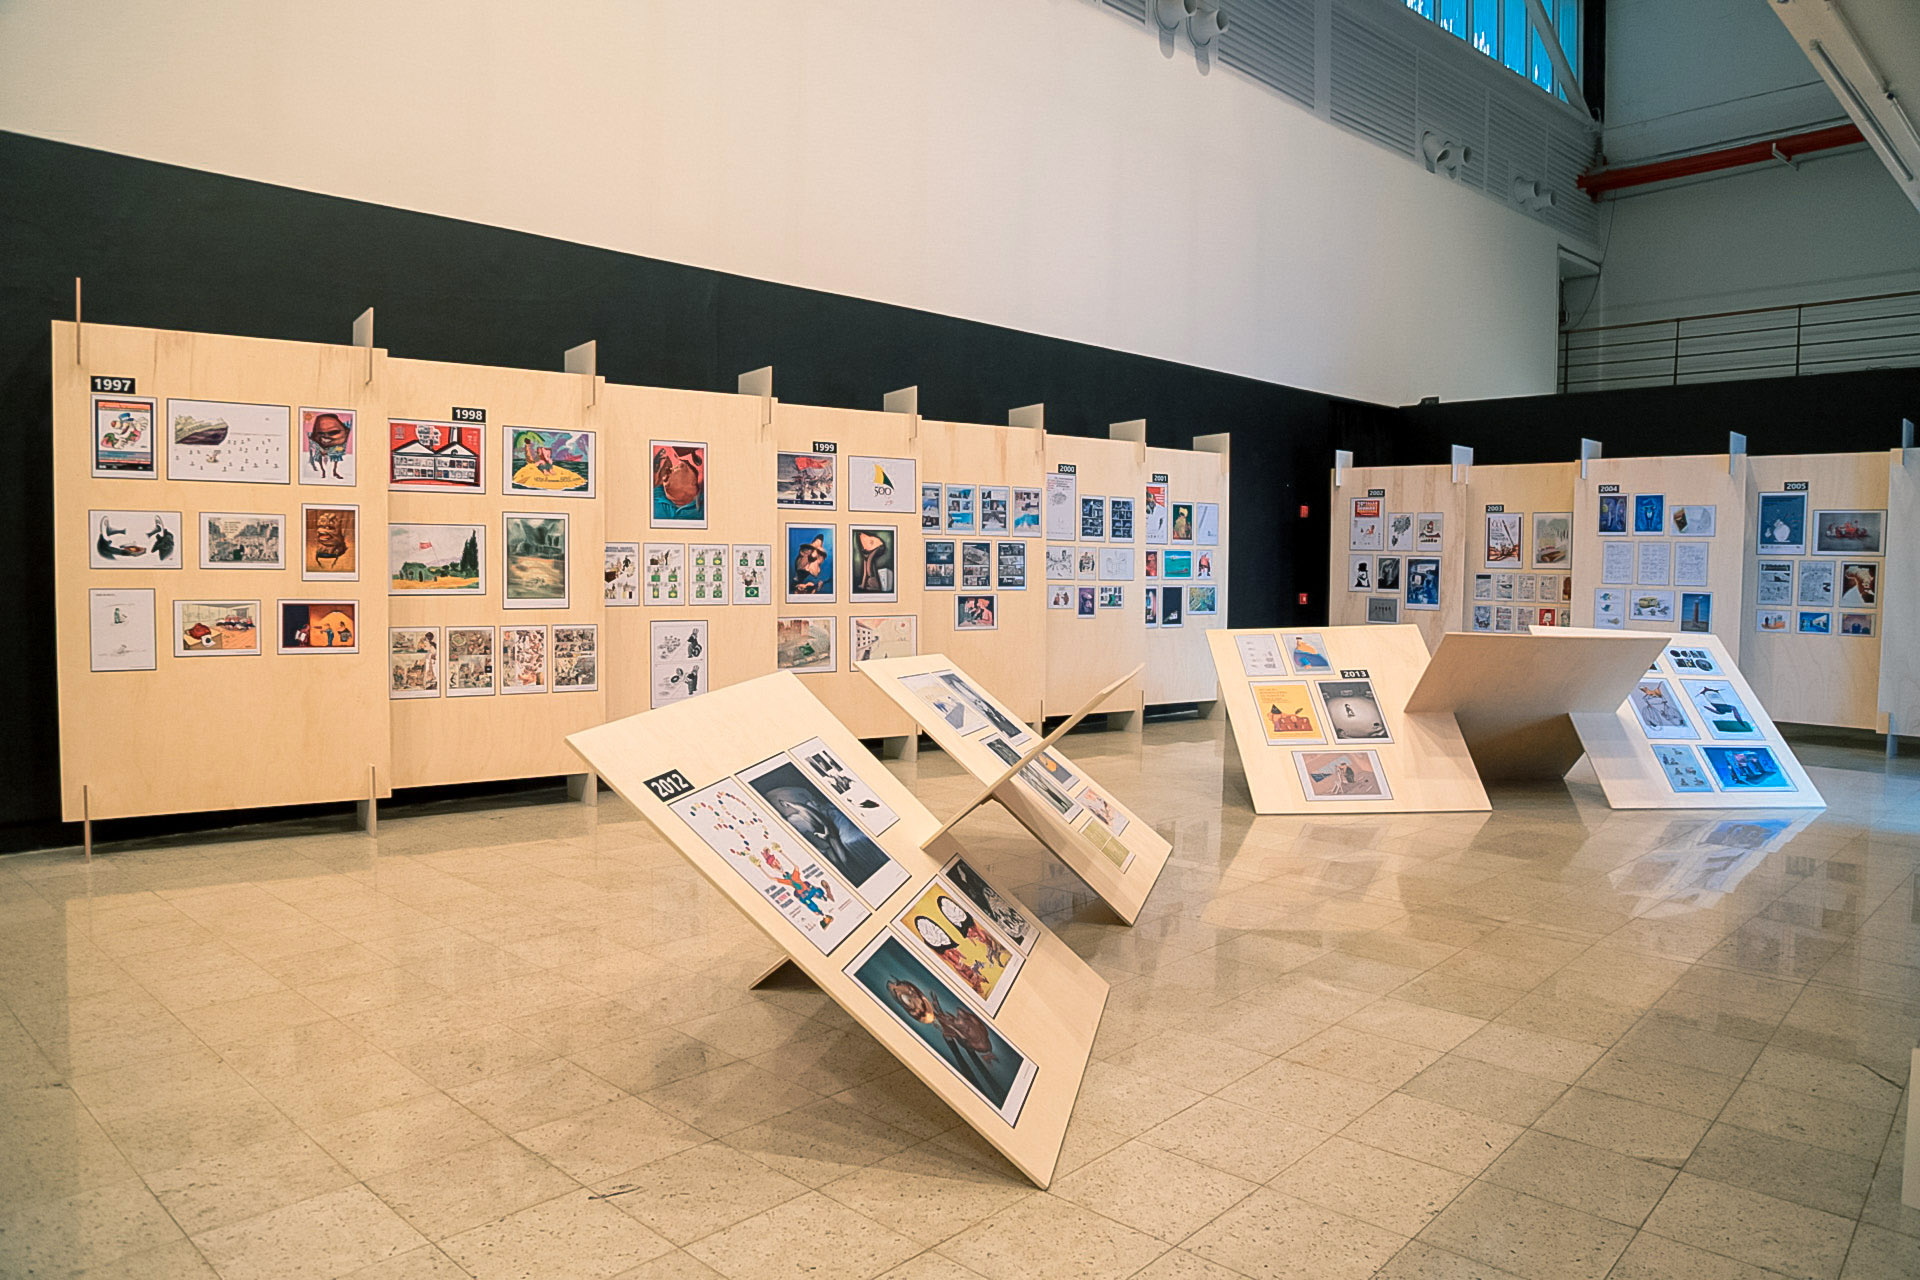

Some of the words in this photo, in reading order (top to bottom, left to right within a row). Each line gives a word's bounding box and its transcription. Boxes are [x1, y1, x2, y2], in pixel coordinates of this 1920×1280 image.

[94, 378, 132, 391] 1997
[455, 409, 483, 421] 1998
[814, 442, 835, 452] 1999
[1059, 465, 1075, 473] 2000
[1154, 474, 1167, 482] 2001
[1786, 482, 1807, 490] 2005
[874, 486, 892, 497] 500
[1343, 670, 1367, 678] 2013
[650, 773, 689, 798] 2012
